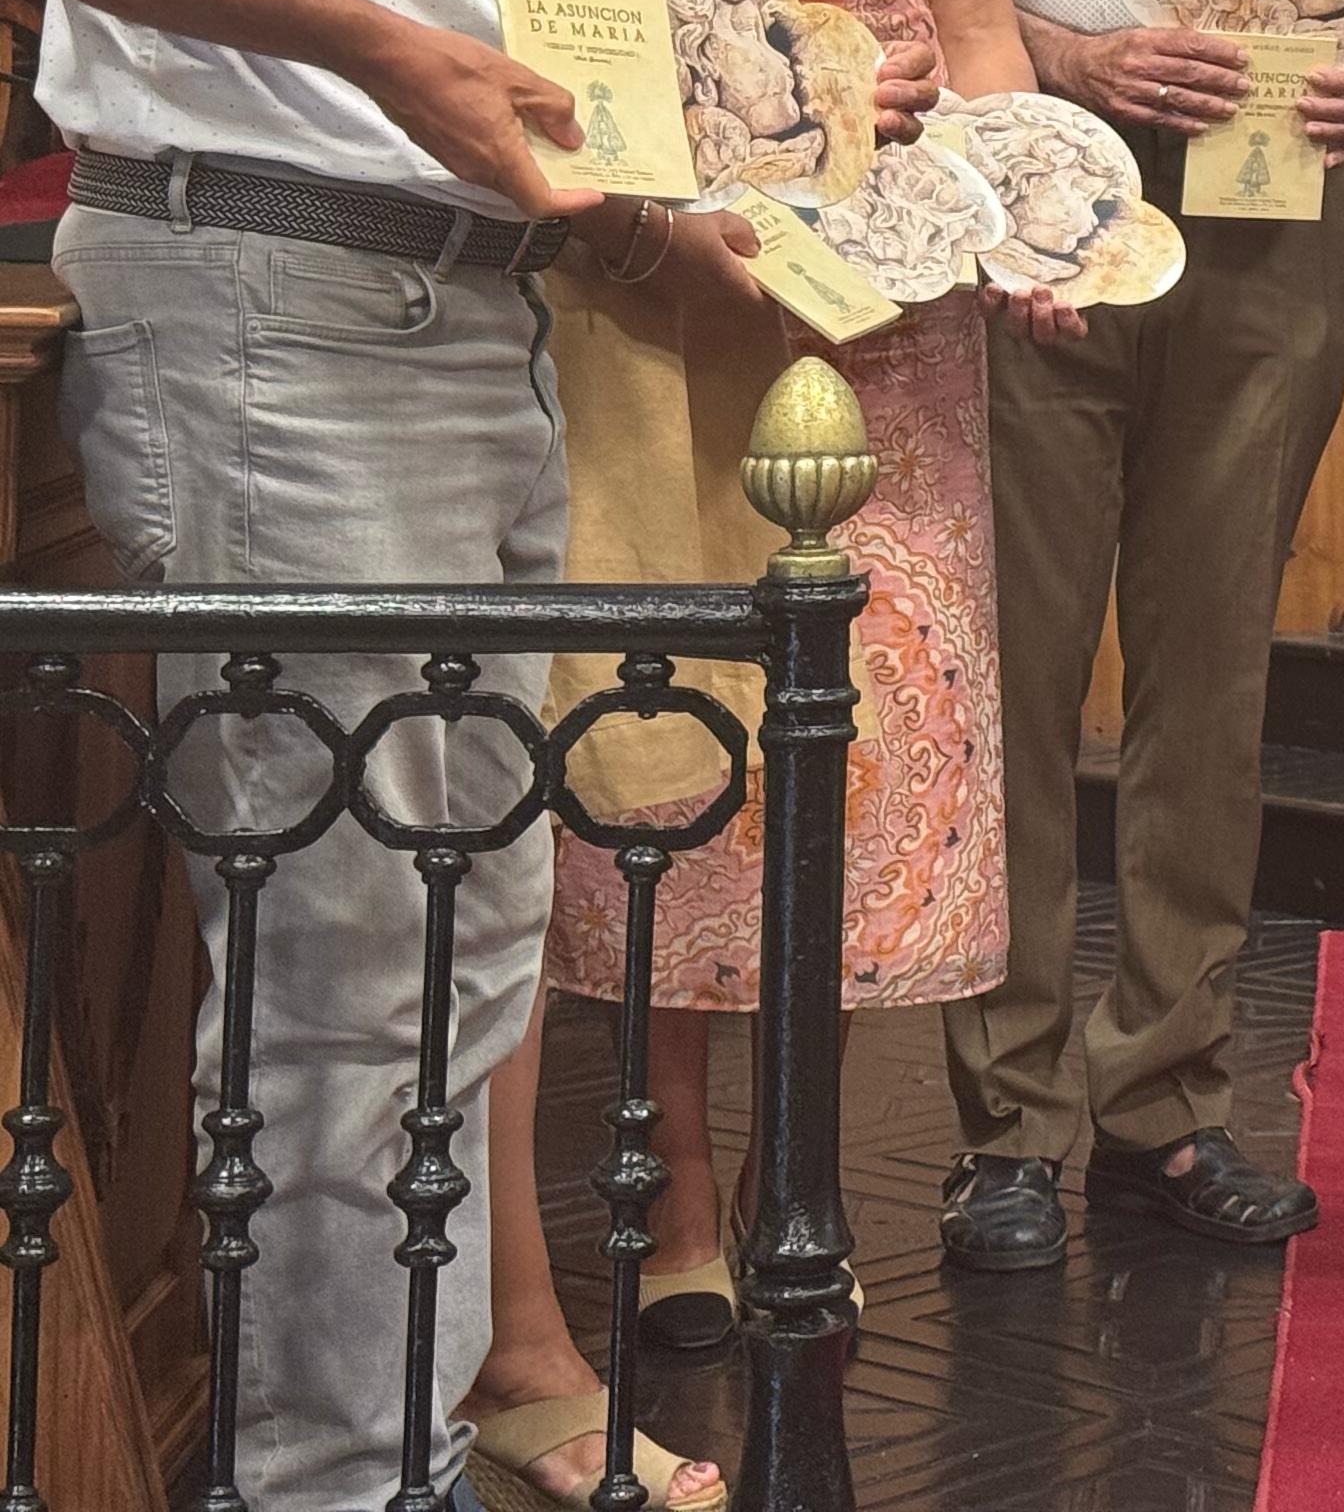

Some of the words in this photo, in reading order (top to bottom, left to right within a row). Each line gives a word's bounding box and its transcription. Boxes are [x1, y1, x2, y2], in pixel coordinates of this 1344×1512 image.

[526, 0, 548, 15] LA
[555, 2, 643, 24] ASUNCION
[530, 19, 558, 34] DE
[571, 22, 646, 43] MARIA
